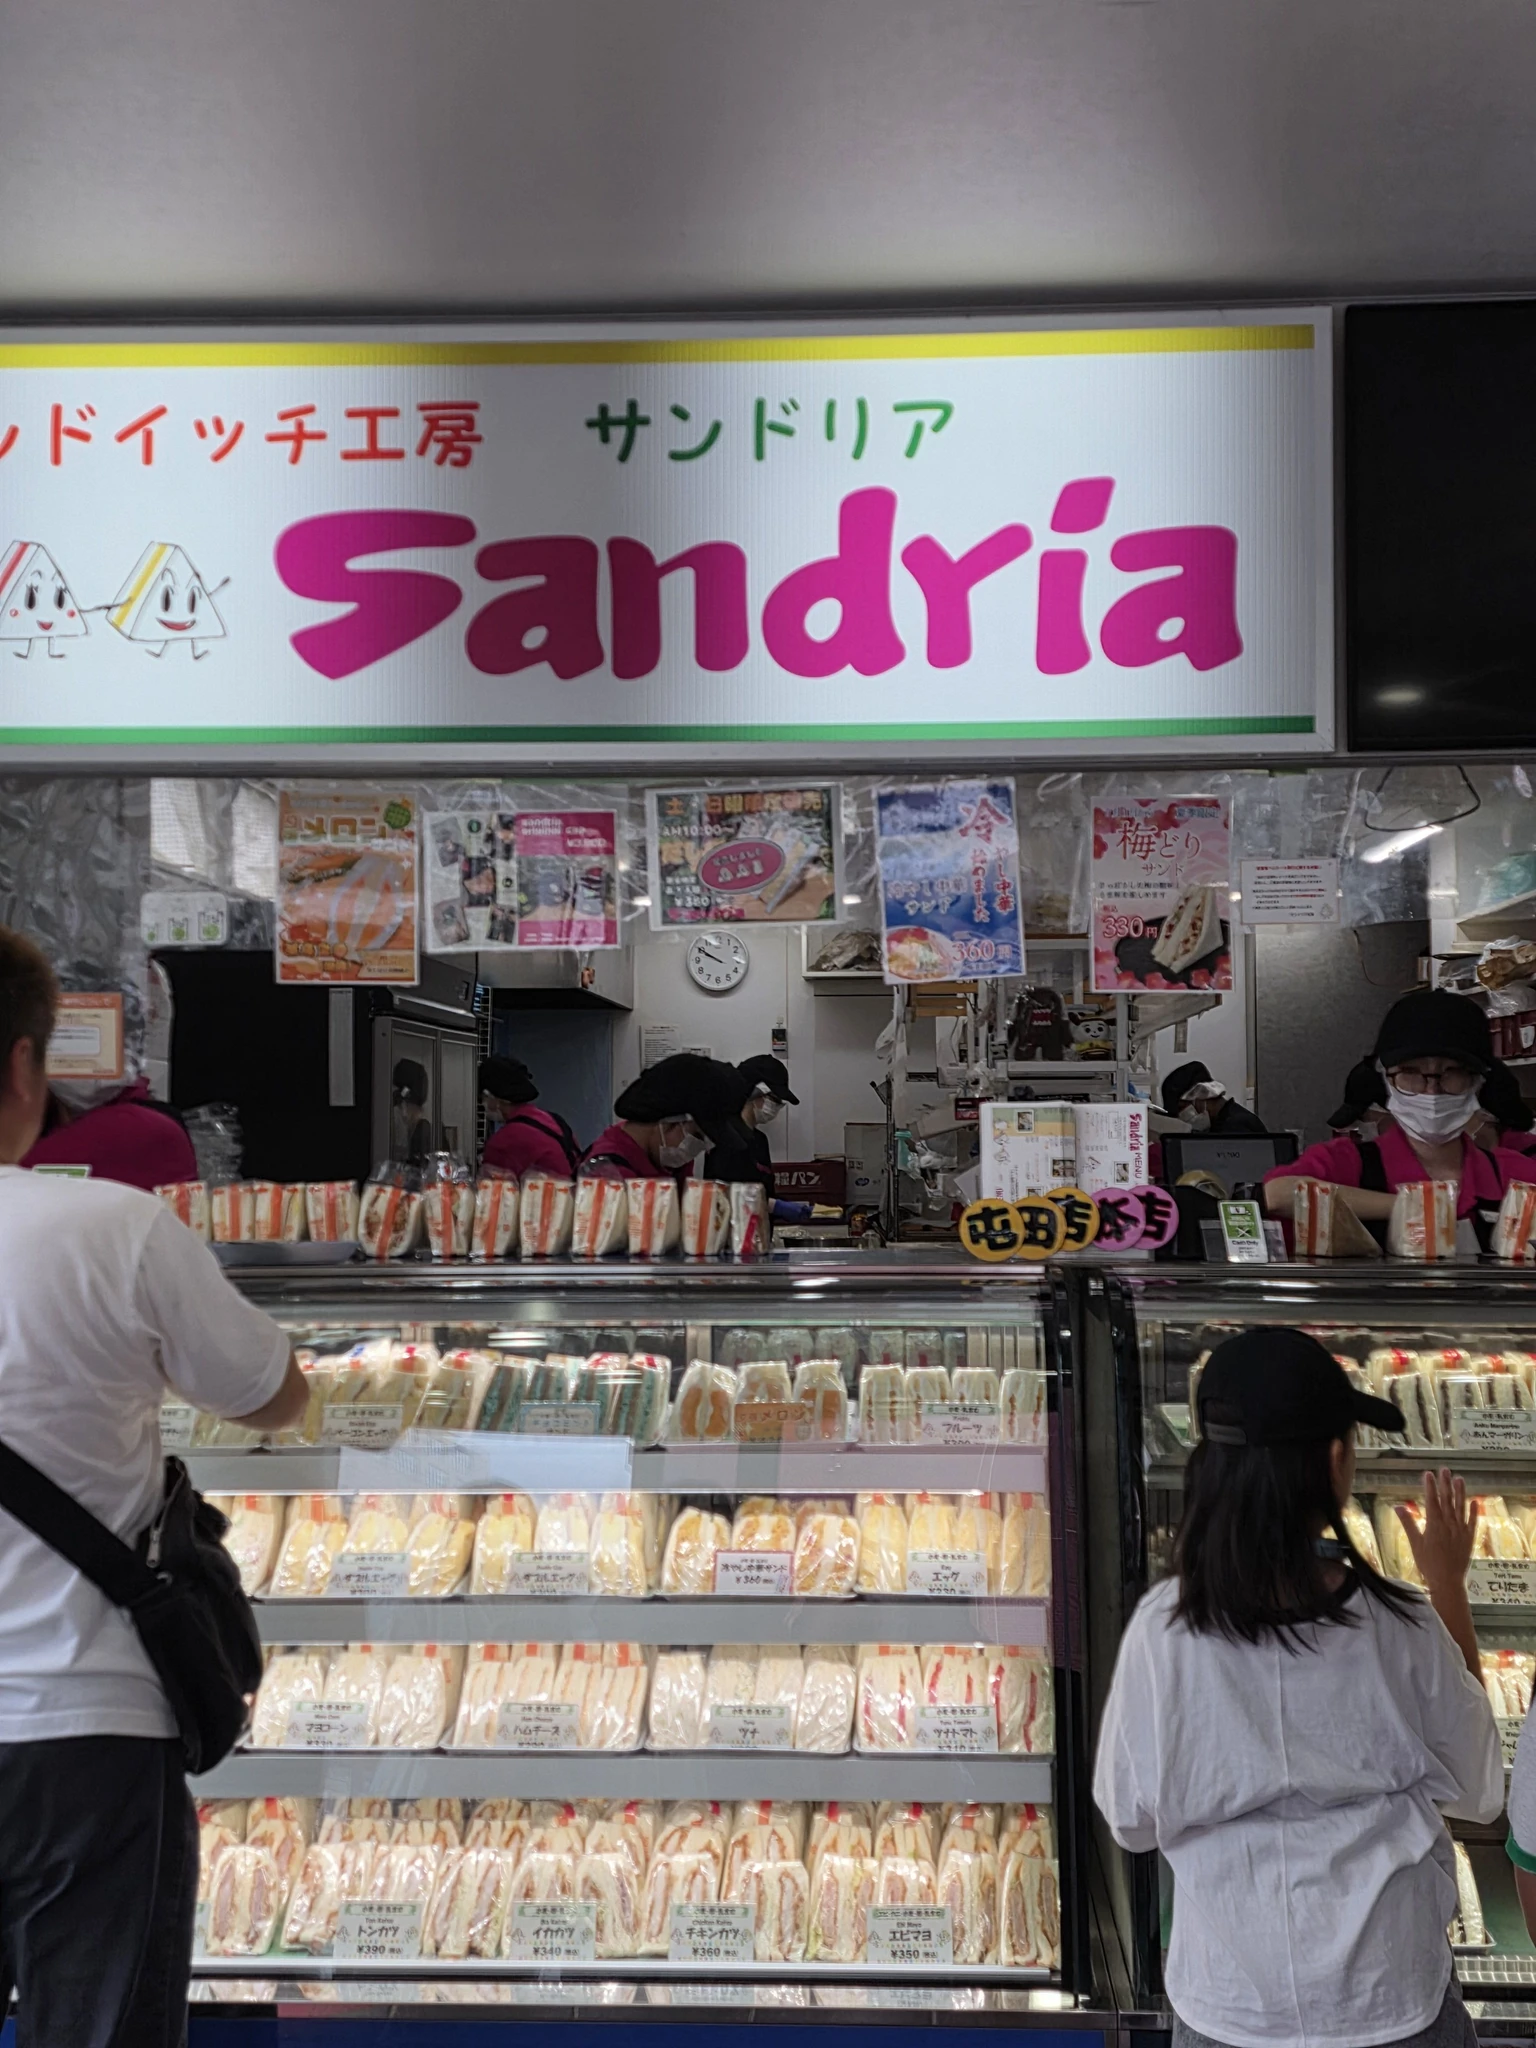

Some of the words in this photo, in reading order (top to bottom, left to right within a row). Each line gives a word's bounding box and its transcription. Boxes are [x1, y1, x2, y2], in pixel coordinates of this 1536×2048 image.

[585, 400, 954, 464] サンドリア
[275, 478, 1243, 680] Sandria
[1116, 821, 1200, 860] 梅どり
[1142, 863, 1184, 877] サンド
[1129, 1113, 1142, 1152] Sandria
[1134, 1153, 1143, 1179] MENU
[968, 1194, 1094, 1251] 屯田店
[942, 1423, 983, 1434] フルーツ
[1473, 1431, 1524, 1439] あんマーガリン
[932, 1571, 960, 1582] エッグ
[1487, 1581, 1530, 1593] てりたま
[305, 1723, 349, 1733] マヨコーン
[738, 1727, 760, 1739] ツナ
[933, 1727, 978, 1738] ツナトマト
[358, 1925, 400, 1937] トンカツ
[532, 1927, 575, 1939] イカカツ
[686, 1927, 740, 1940] チキンカツ
[889, 1930, 932, 1941] エビマヨ
[357, 1945, 386, 1955] ¥390
[692, 1947, 721, 1957] ¥360
[890, 1949, 920, 1959] ¥350
